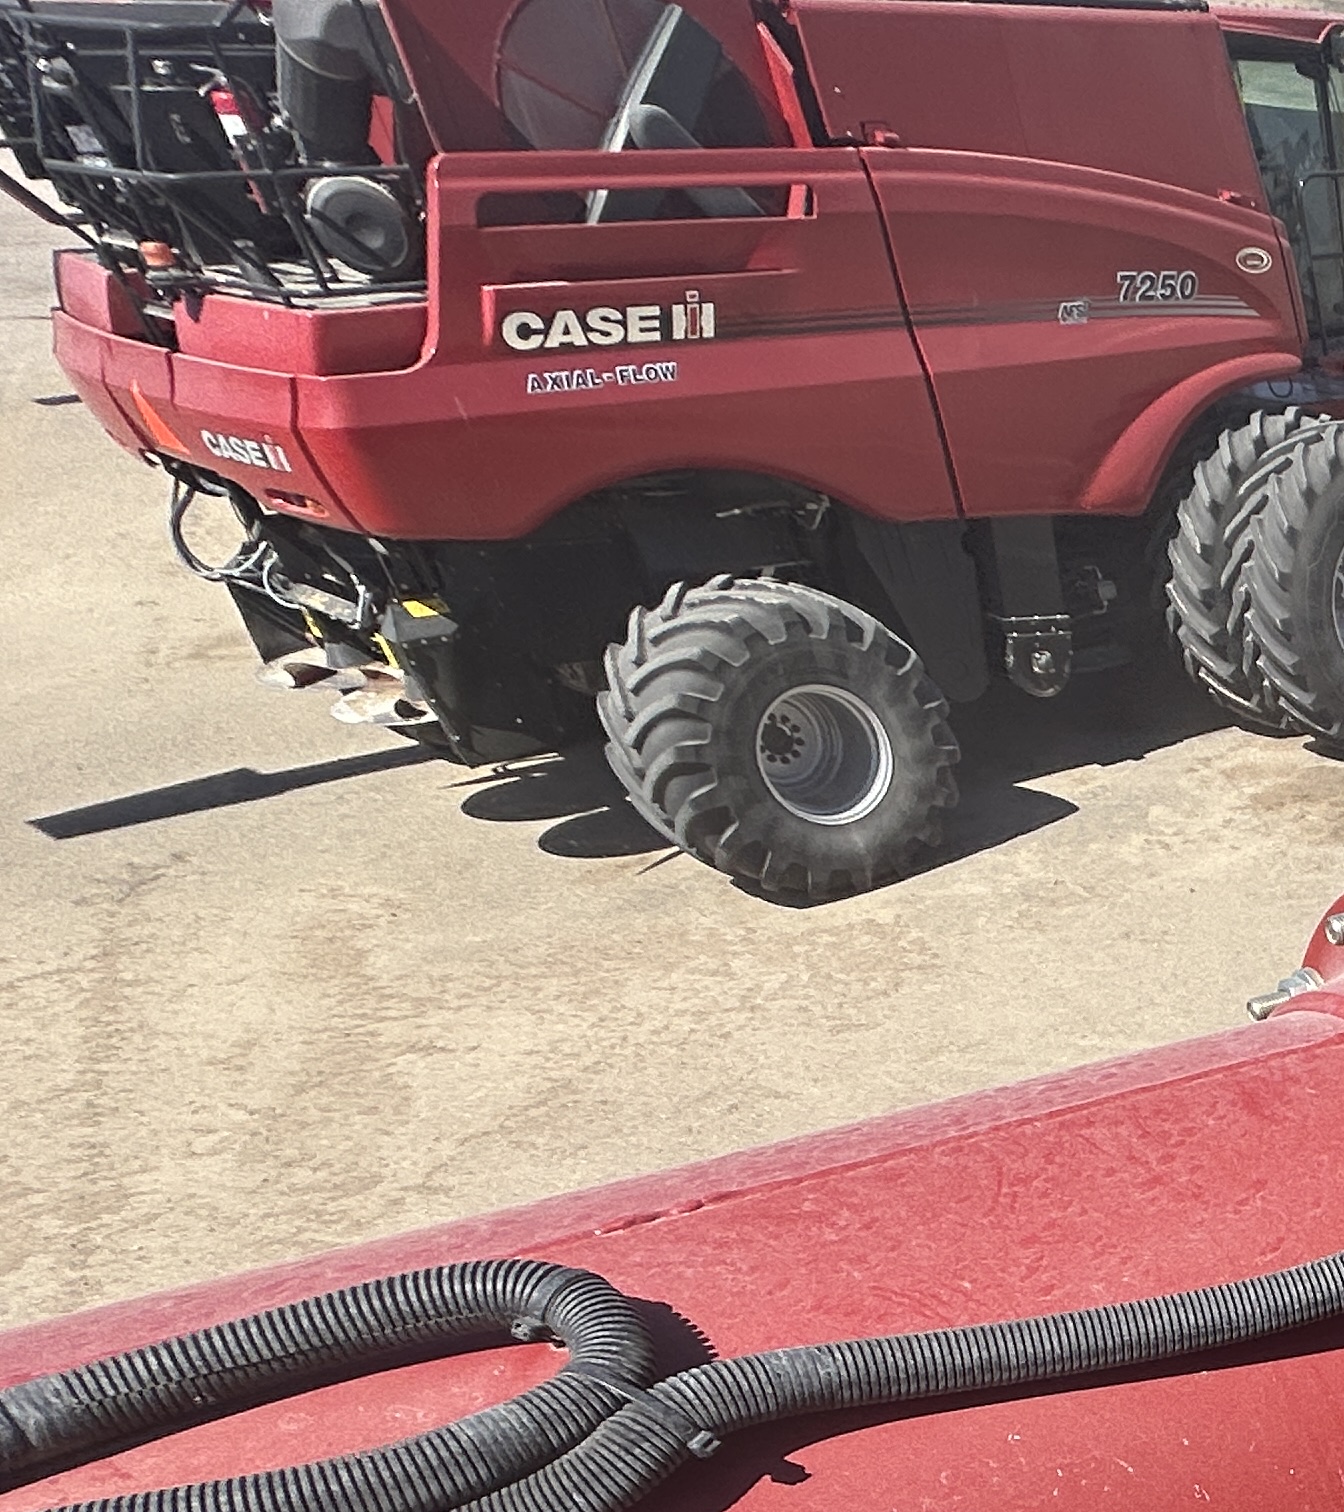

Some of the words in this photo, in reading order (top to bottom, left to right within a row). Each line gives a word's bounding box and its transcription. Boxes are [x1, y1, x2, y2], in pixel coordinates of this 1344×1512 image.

[1116, 271, 1198, 303] 7250
[501, 305, 662, 351] CASE
[526, 361, 678, 395] AXIAL-FLOW
[200, 429, 271, 469] CASE
